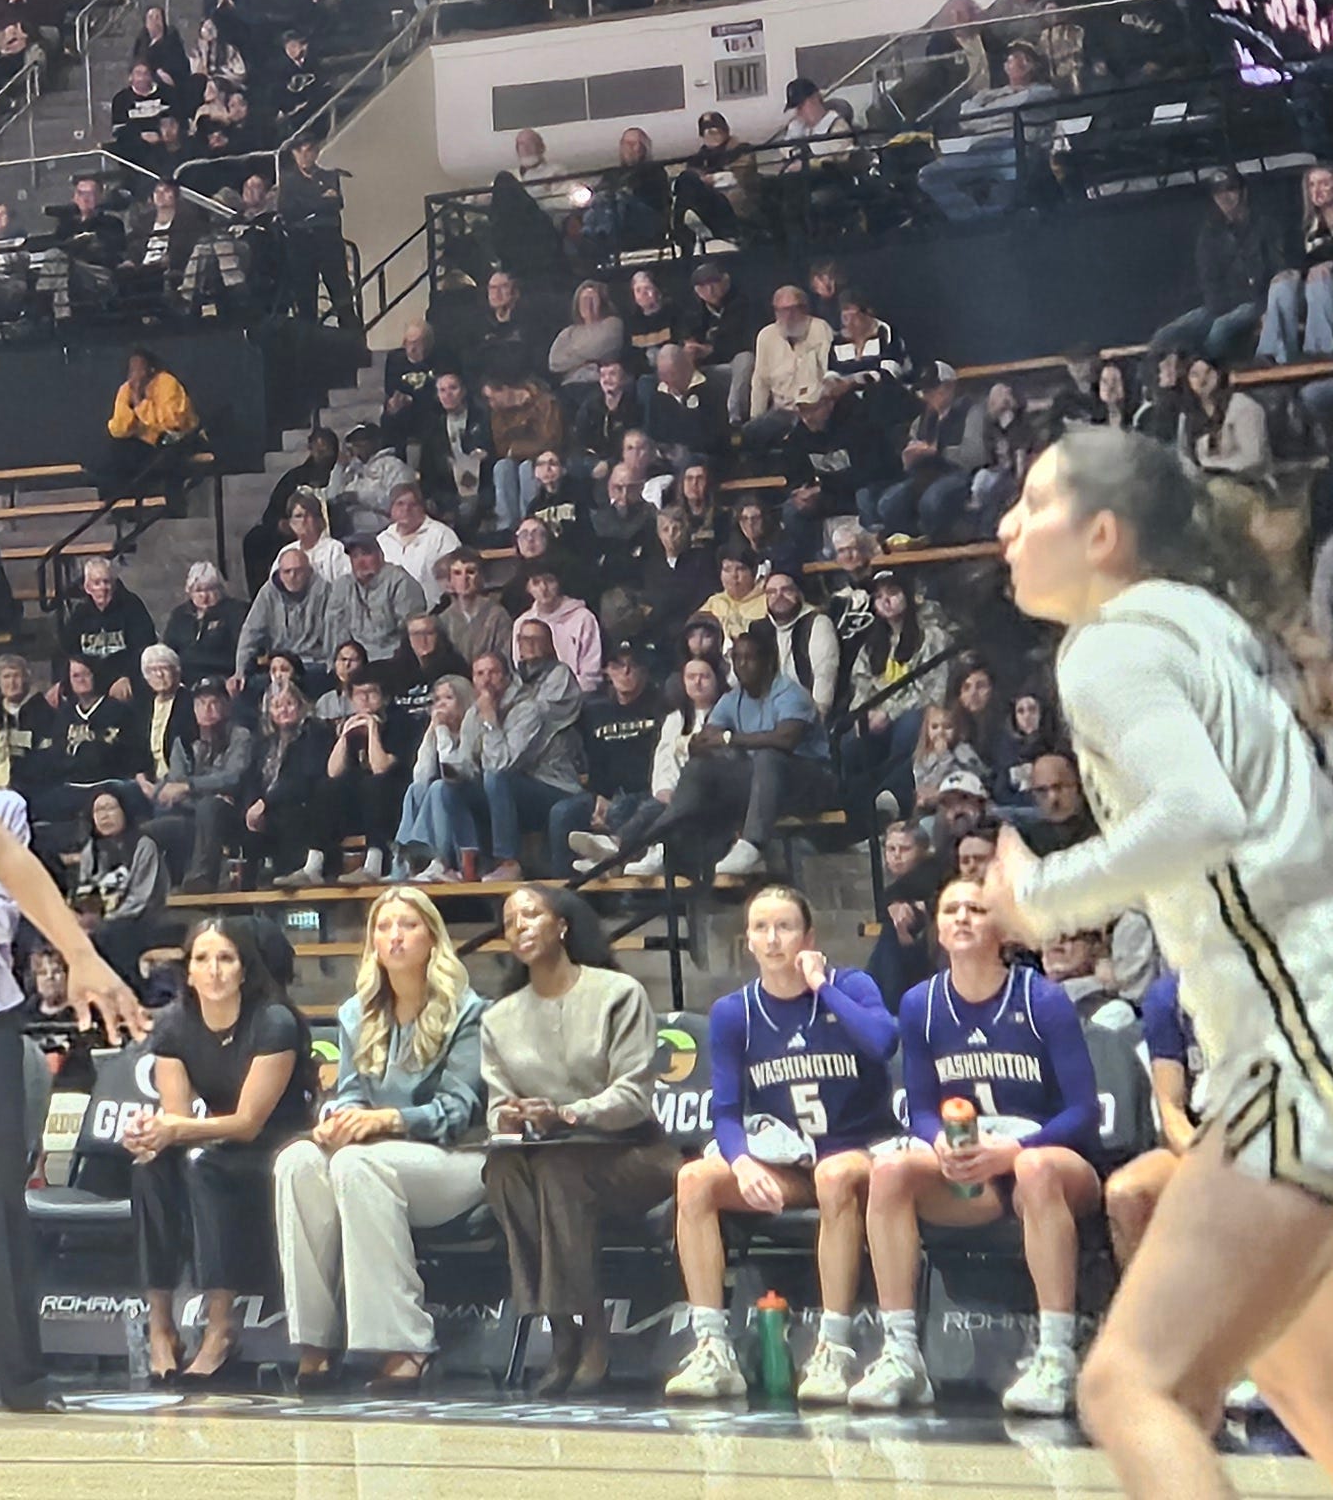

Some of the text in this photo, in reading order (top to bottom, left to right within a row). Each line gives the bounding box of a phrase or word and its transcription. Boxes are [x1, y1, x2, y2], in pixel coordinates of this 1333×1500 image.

[749, 1052, 859, 1090] WASHINGTON
[934, 1052, 1042, 1084] WASHINGTON
[789, 1082, 829, 1136] 5
